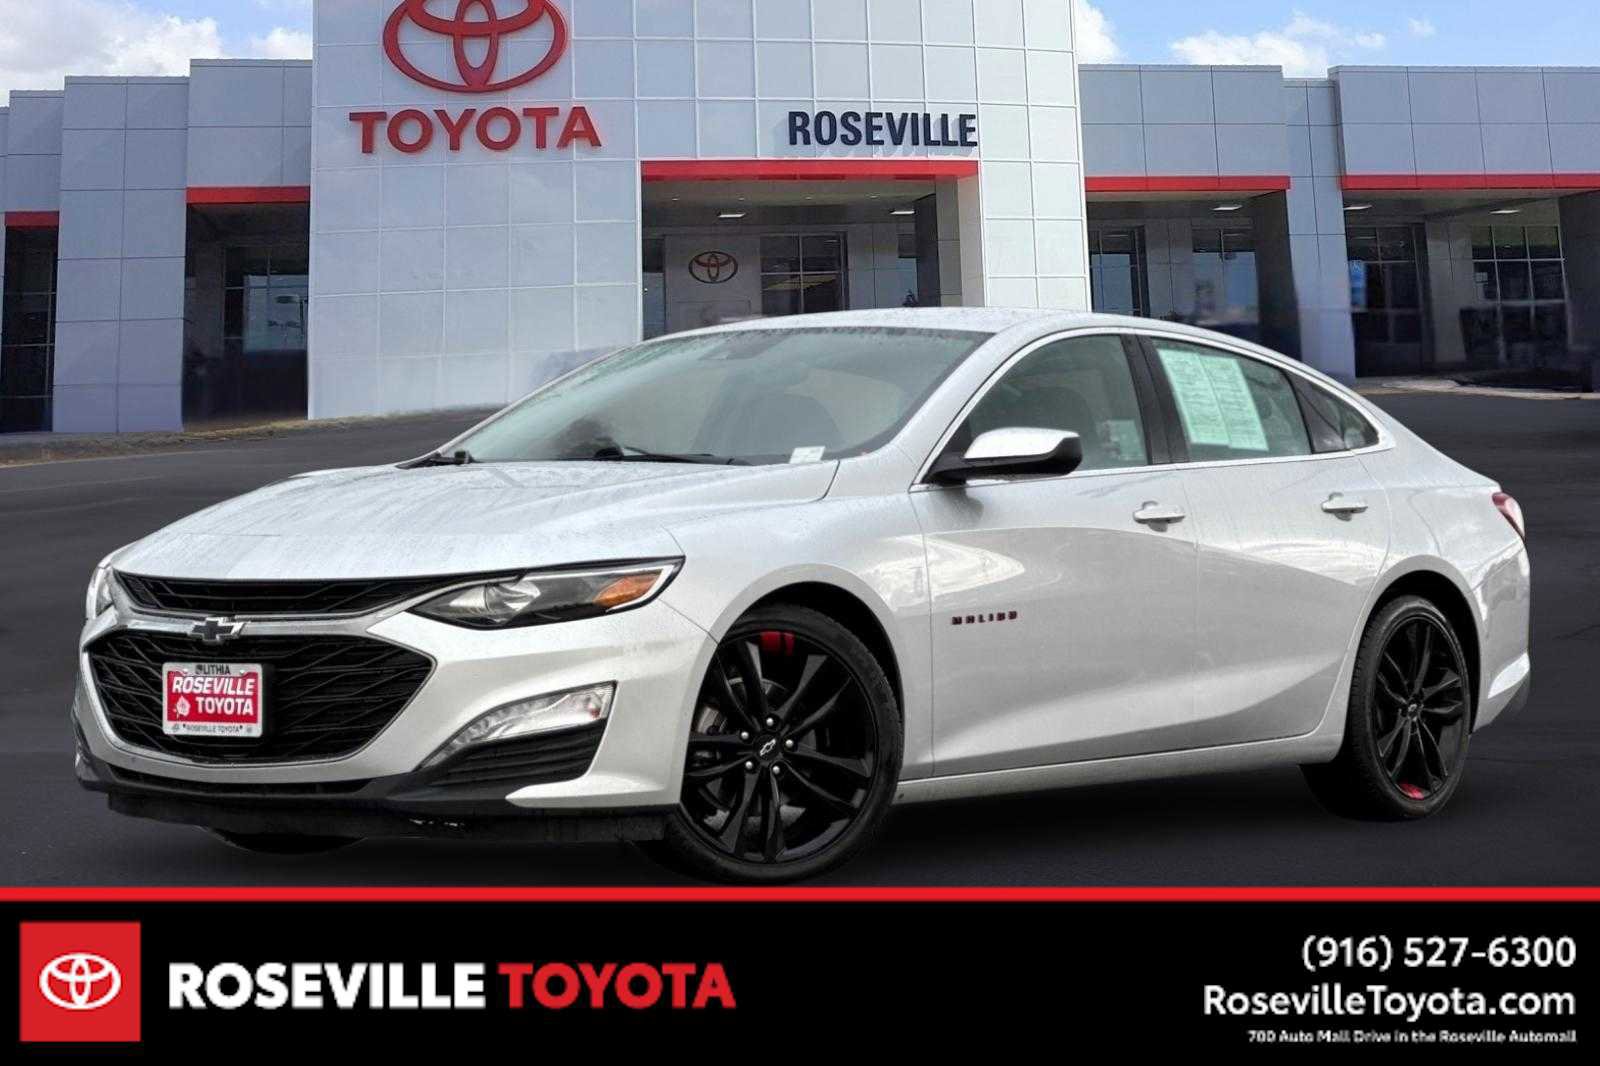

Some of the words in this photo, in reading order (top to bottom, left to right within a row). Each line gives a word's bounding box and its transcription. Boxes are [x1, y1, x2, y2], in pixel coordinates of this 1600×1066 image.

[350, 106, 602, 153] TOYOTA
[789, 111, 977, 147] ROSEVILLE
[203, 664, 231, 675] LITHIA
[172, 676, 255, 695] ROSEVILLE
[195, 697, 254, 715] TOYOTA
